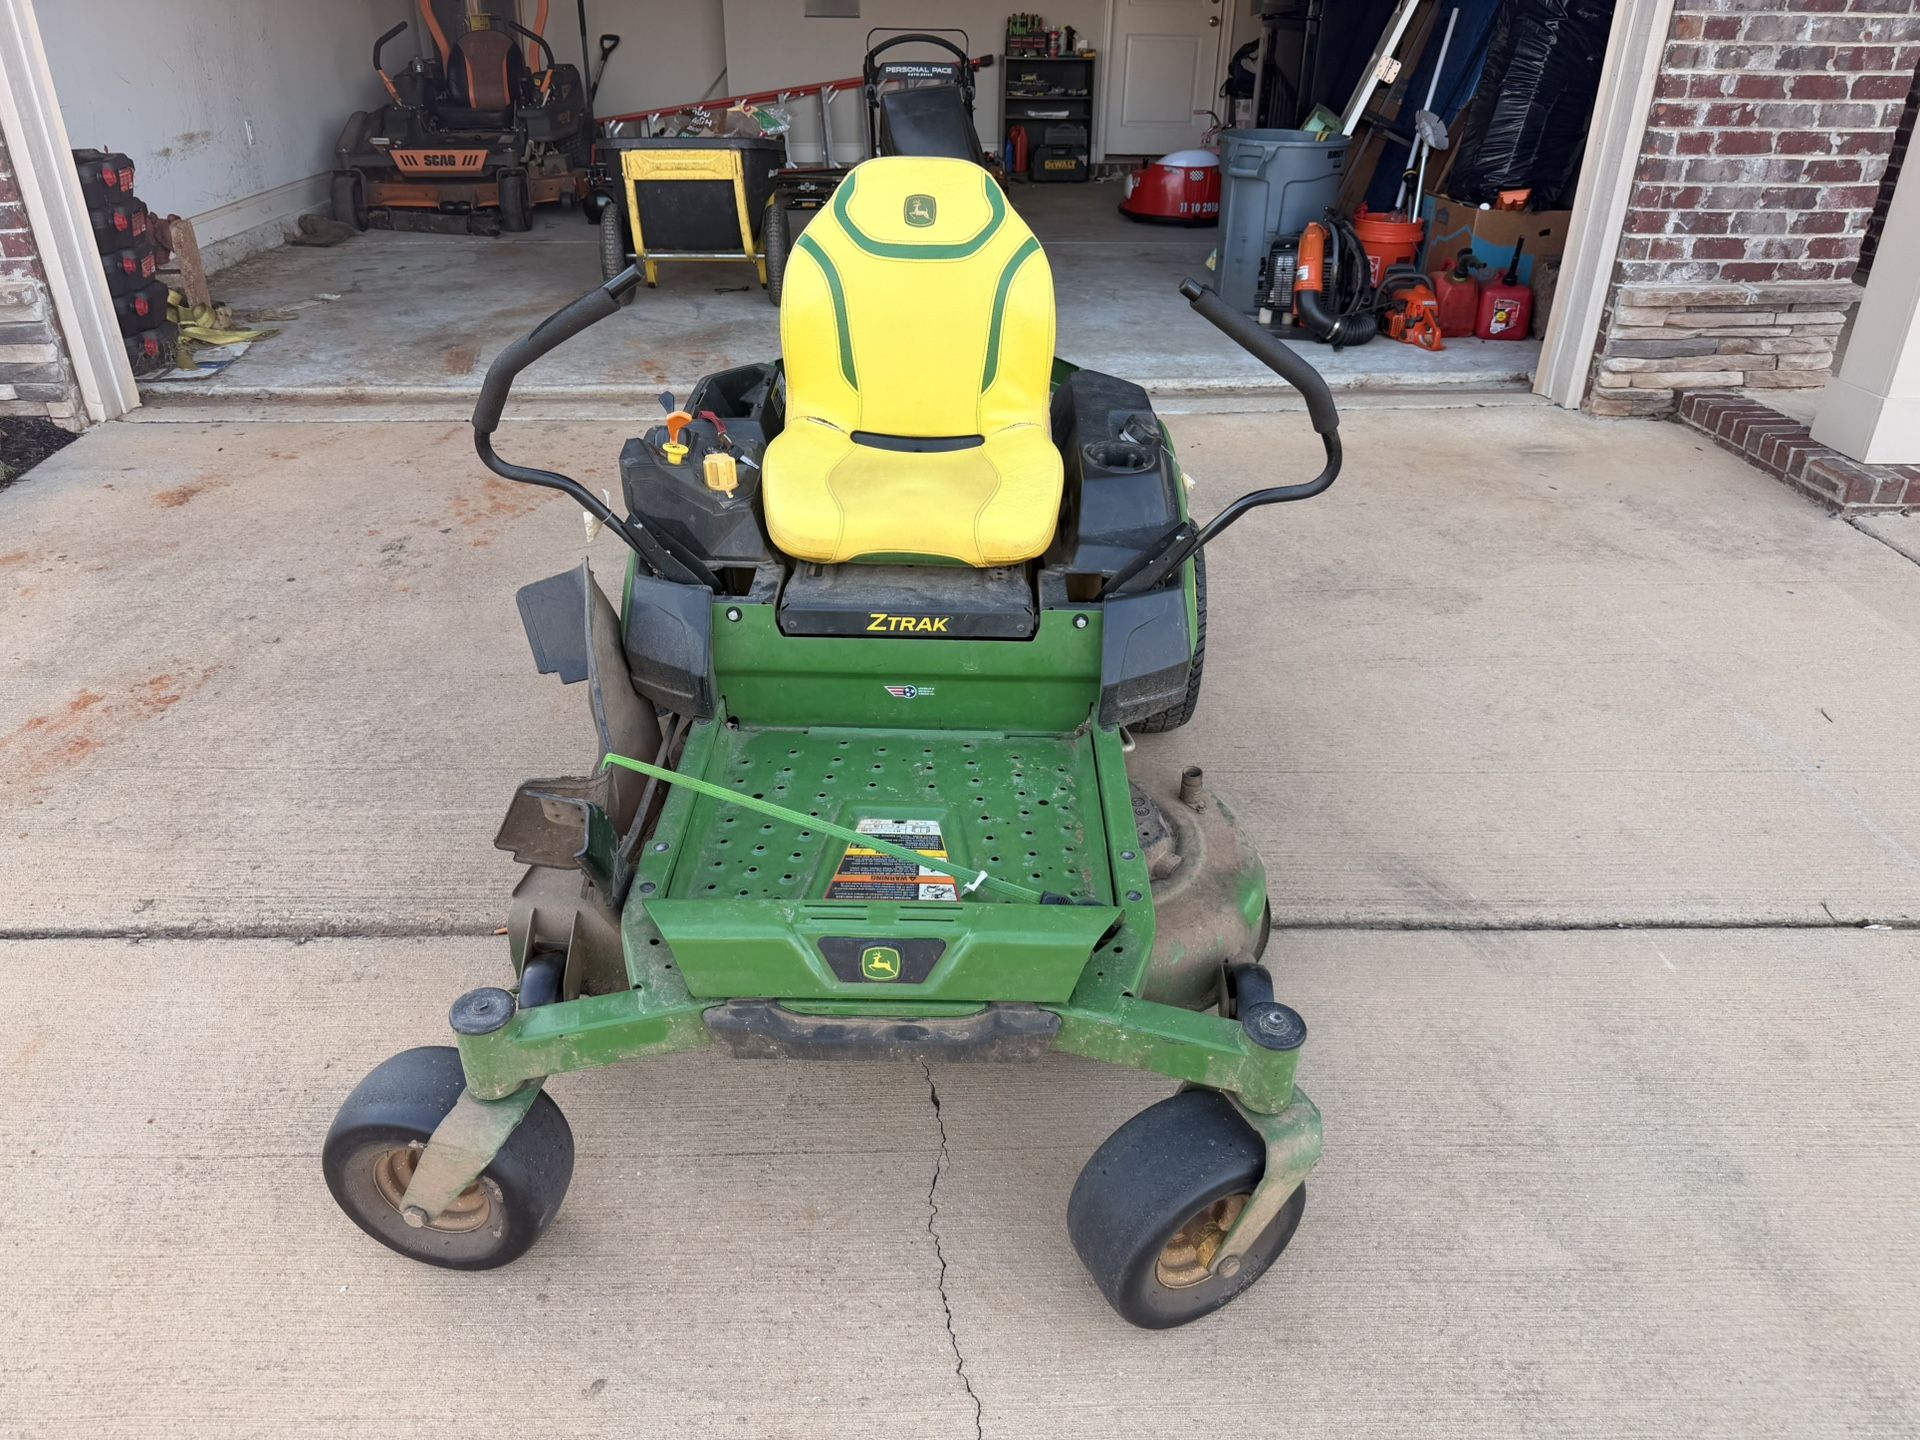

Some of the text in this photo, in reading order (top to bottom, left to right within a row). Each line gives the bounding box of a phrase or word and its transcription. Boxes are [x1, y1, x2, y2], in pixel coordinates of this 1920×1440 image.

[423, 155, 456, 166] SCAG
[1044, 159, 1077, 169] DEWALT
[1179, 202, 1188, 213] 11
[1191, 202, 1201, 213] 10
[866, 613, 950, 632] ZTRAK
